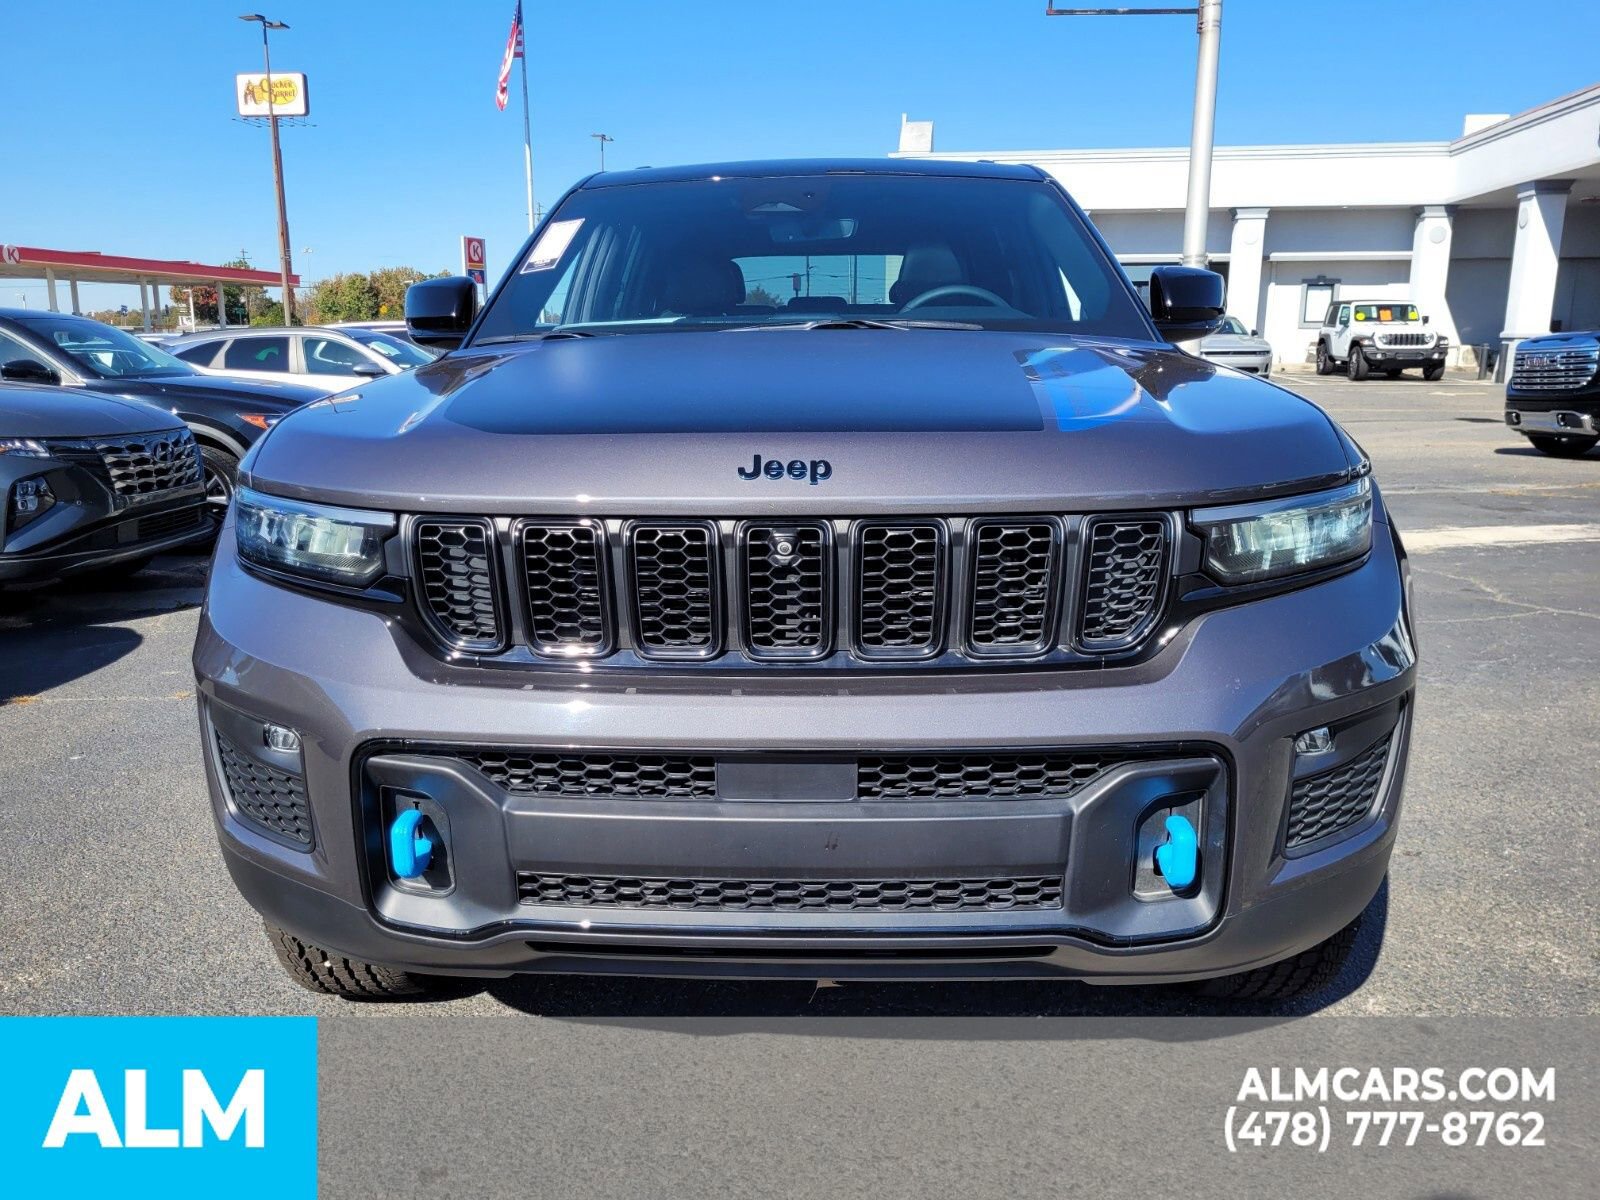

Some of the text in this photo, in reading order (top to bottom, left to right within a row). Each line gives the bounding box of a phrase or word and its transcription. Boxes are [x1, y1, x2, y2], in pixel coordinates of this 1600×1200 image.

[259, 79, 293, 93] Cacker
[7, 247, 20, 263] K
[737, 454, 832, 485] Jeep
